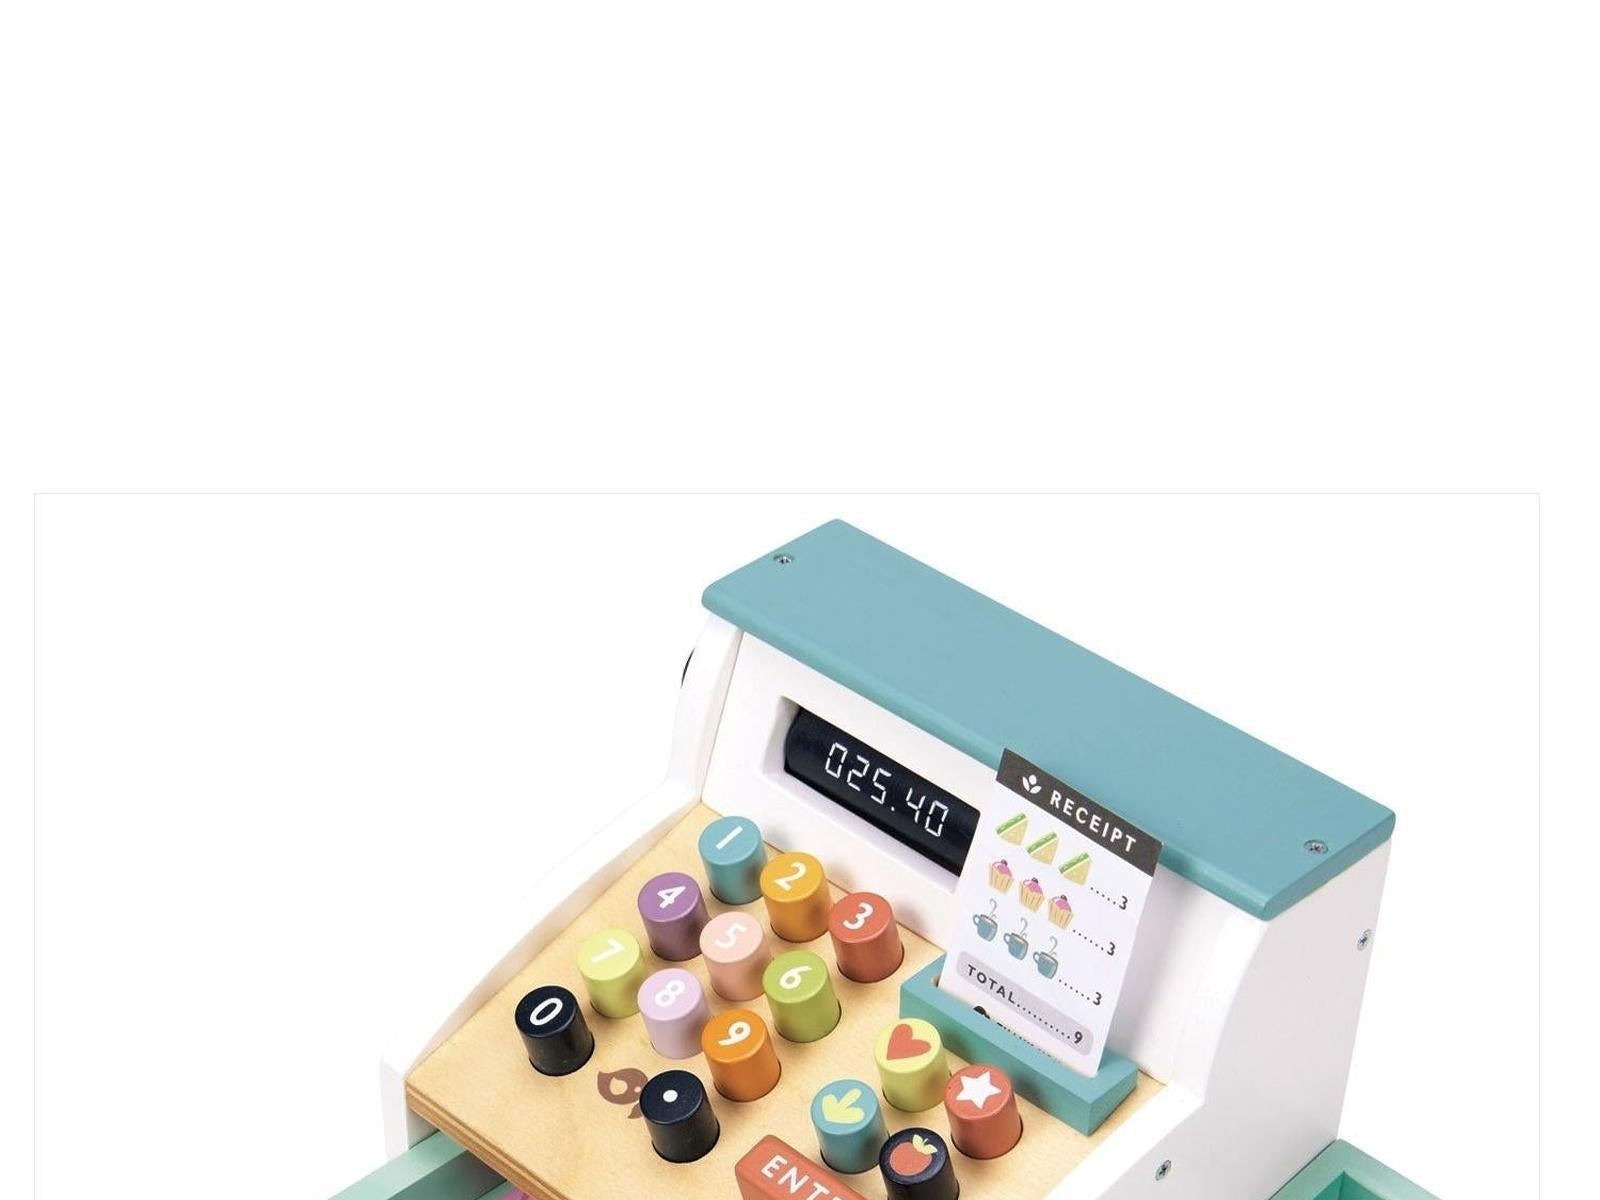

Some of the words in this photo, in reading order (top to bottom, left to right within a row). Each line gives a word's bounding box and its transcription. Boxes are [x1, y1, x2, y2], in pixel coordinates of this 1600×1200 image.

[824, 741, 949, 839] 025.40
[1050, 789, 1138, 853] RECEIPT
[715, 825, 743, 850] 1
[774, 861, 809, 892] 2
[656, 884, 688, 909] 4
[842, 902, 875, 931] 3
[714, 922, 746, 948] 5
[590, 942, 626, 967] 7
[778, 965, 812, 989] 6
[654, 979, 687, 1008] 8
[529, 997, 564, 1026] 0
[717, 1021, 752, 1048] 9
